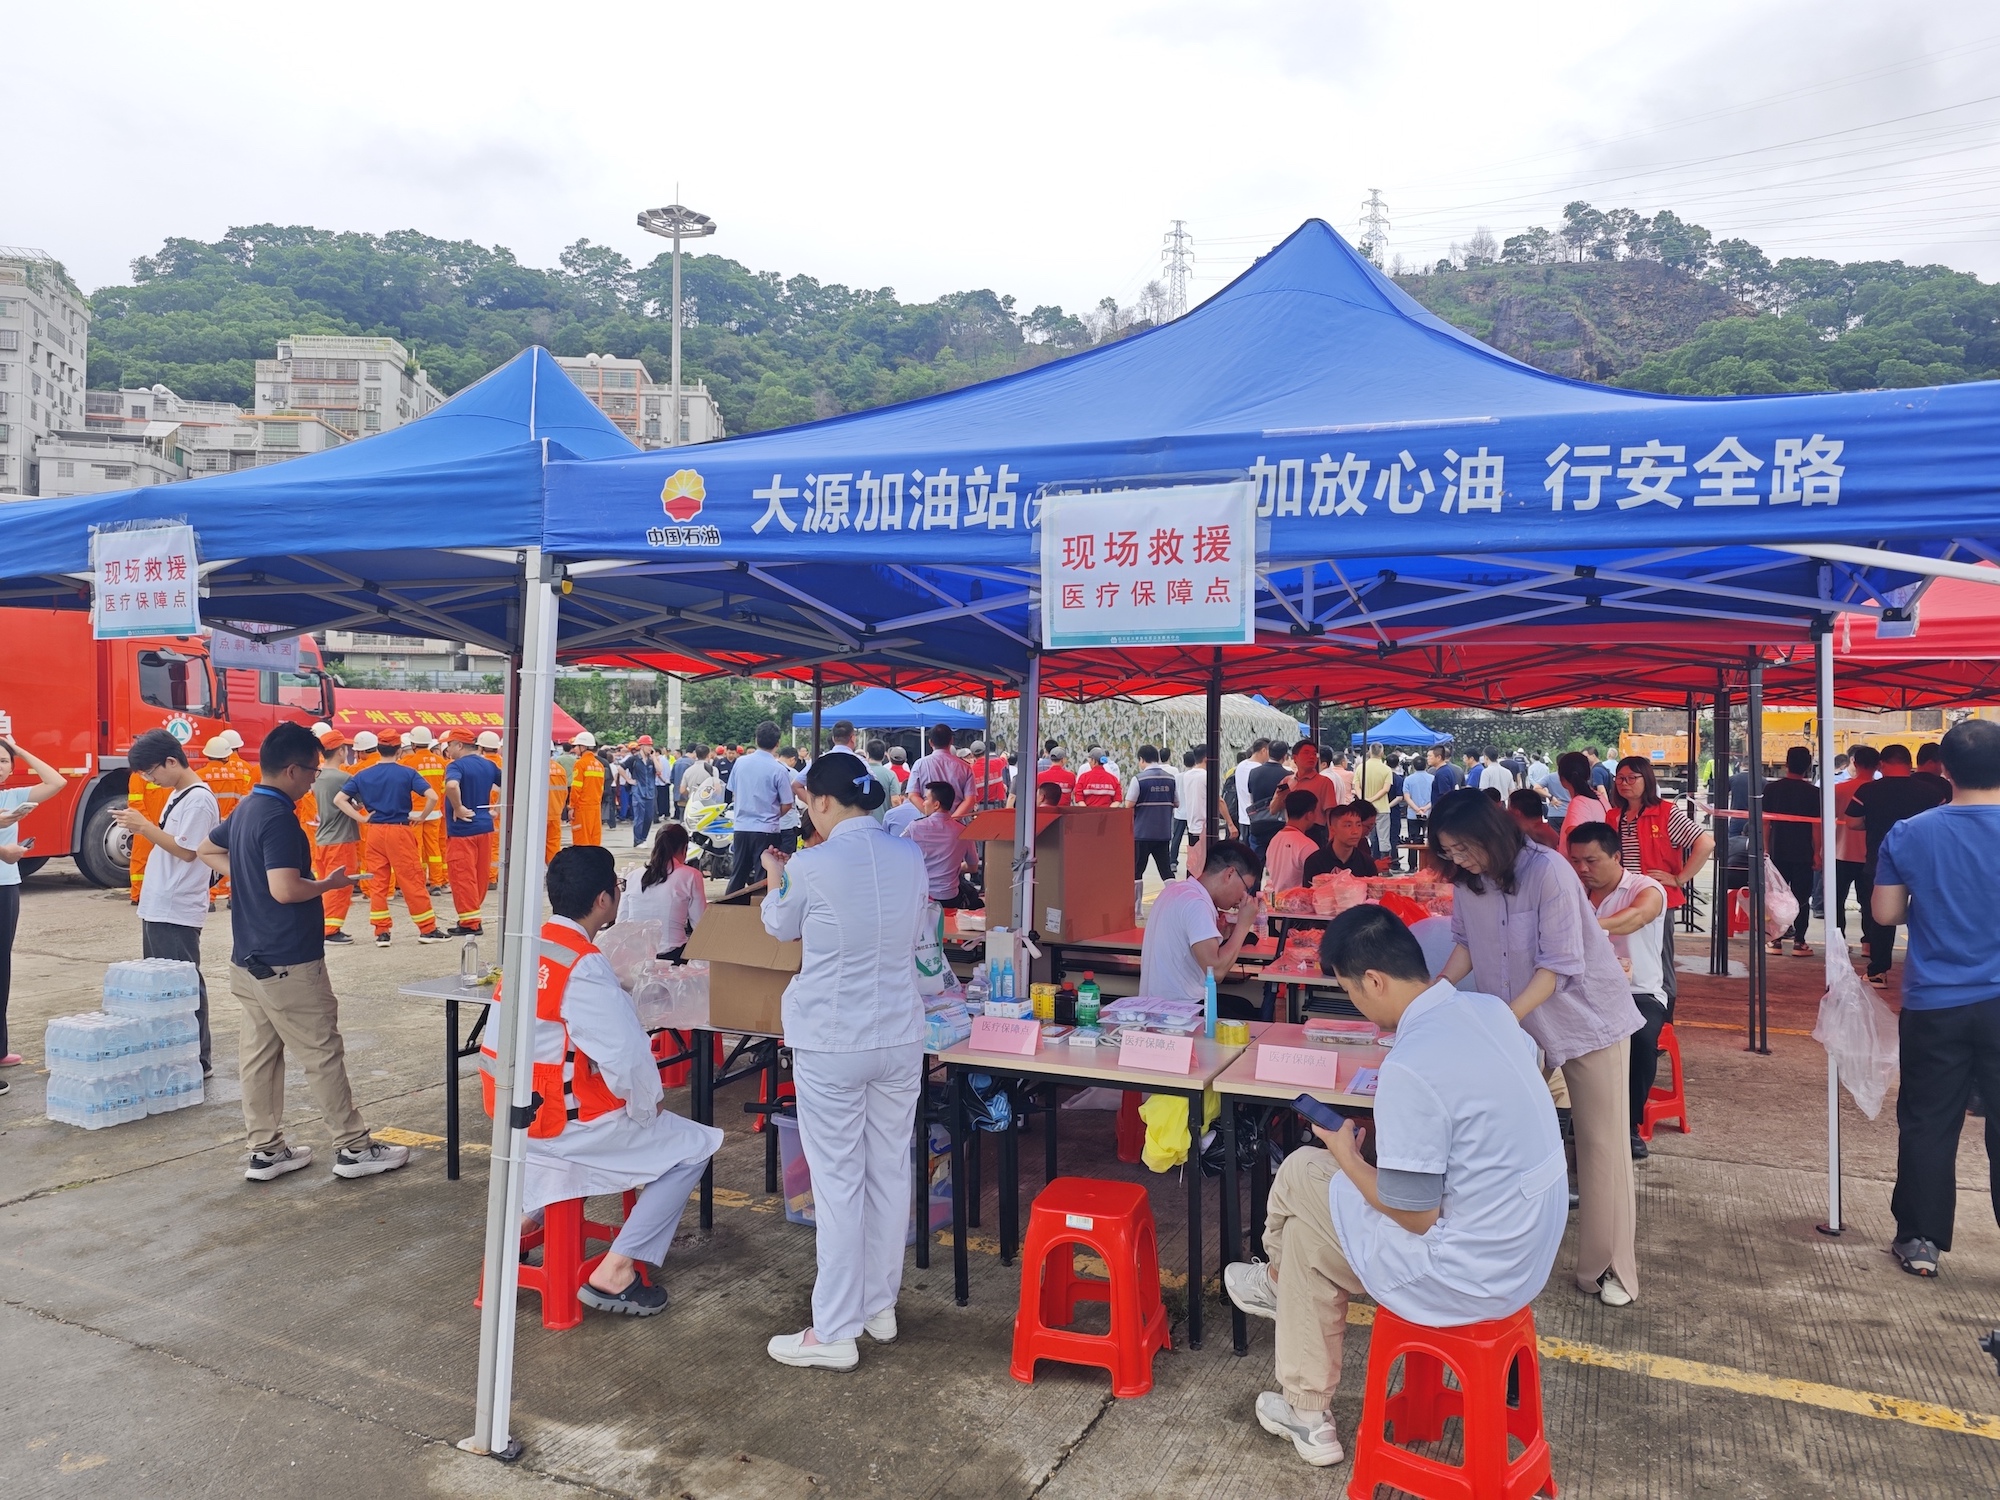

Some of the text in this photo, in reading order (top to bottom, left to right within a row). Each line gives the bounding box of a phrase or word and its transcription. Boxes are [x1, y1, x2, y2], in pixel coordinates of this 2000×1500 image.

[1250, 447, 1505, 517] 加放心油
[1543, 434, 1846, 512] 行安全路
[751, 464, 1020, 535] 大源加油站
[646, 525, 720, 547] 中国石油
[1061, 524, 1232, 571] 现场救援
[104, 554, 187, 586] 现场救援
[105, 589, 187, 612] 医疗保障点
[1062, 577, 1231, 609] 医疗保障点
[338, 708, 504, 726] 广州市消防救援
[982, 1021, 1030, 1035] 医疗保障点
[1125, 1035, 1176, 1051] 医疗保障点
[1269, 1051, 1327, 1068] 医疗保障点
